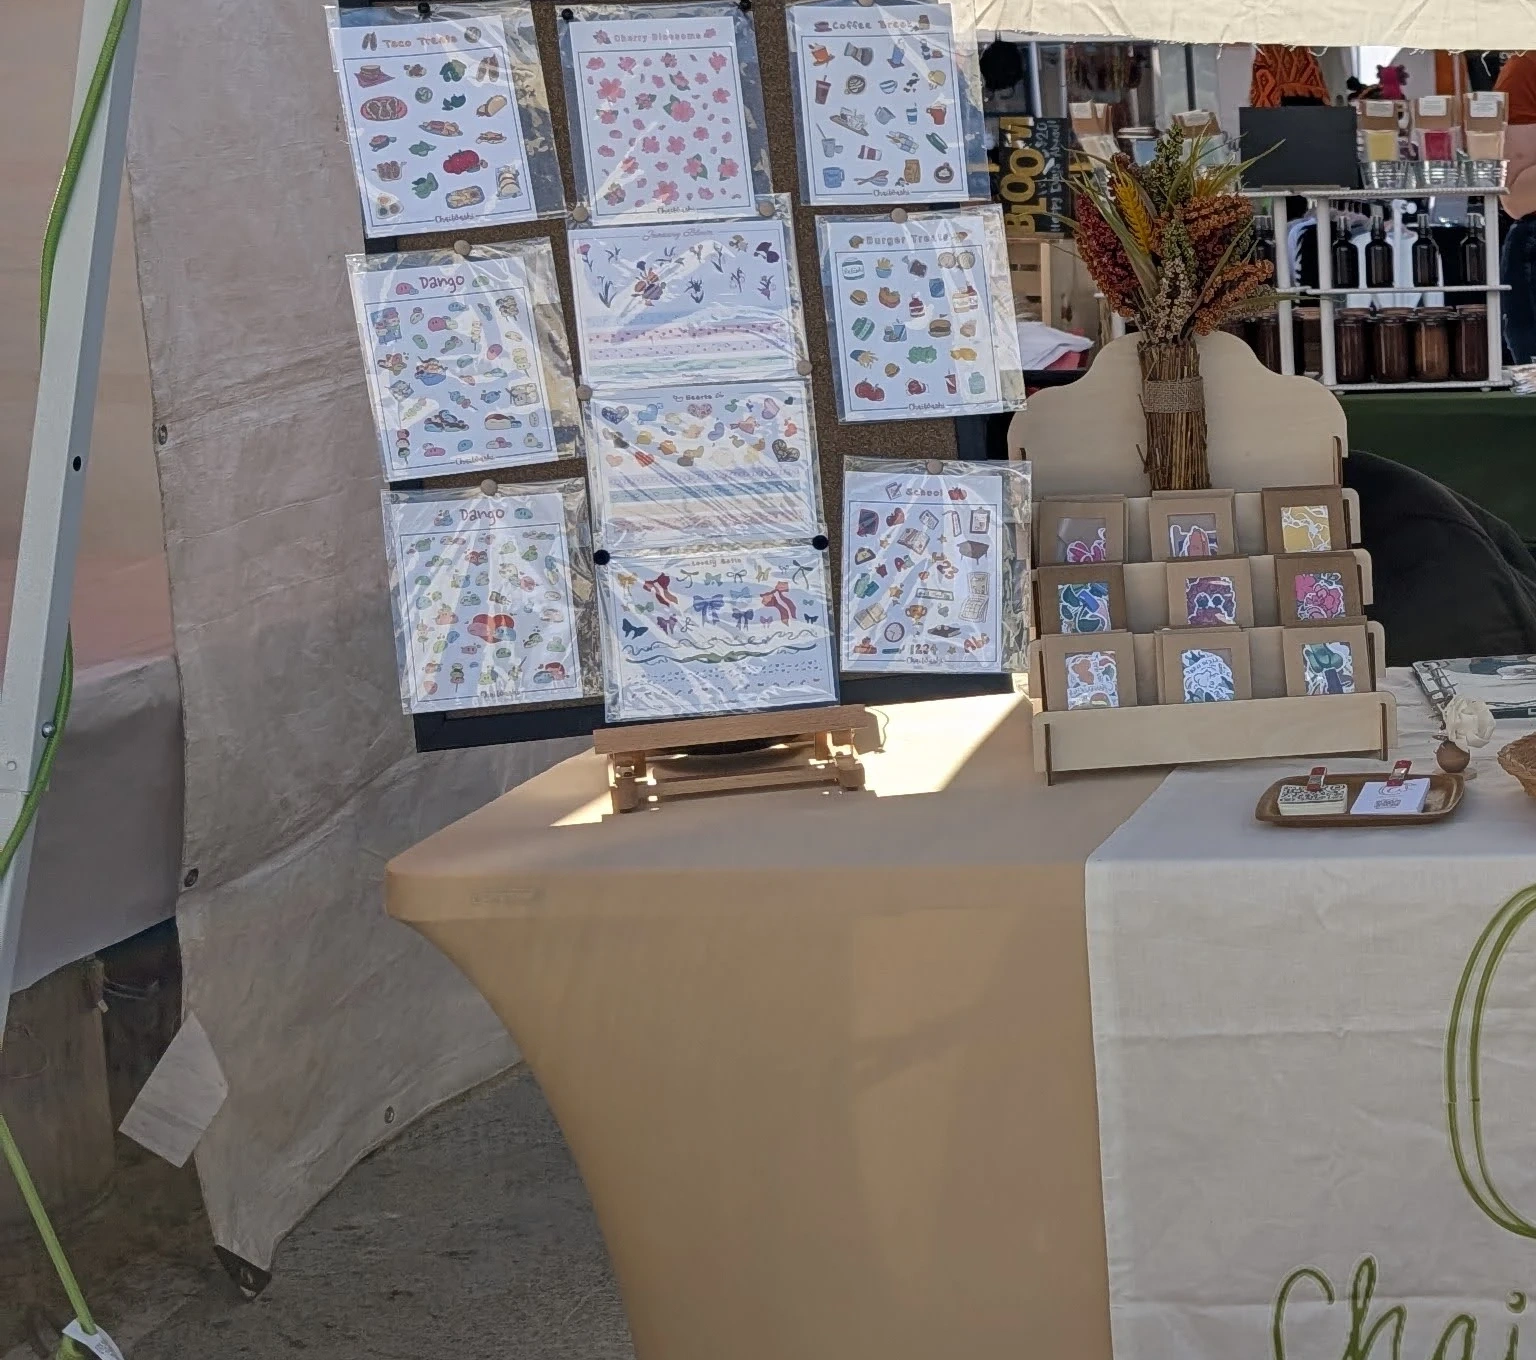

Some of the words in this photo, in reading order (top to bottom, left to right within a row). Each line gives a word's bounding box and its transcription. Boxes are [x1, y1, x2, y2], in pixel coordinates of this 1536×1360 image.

[832, 21, 872, 30] Coffee
[418, 275, 465, 293] Dango
[458, 508, 505, 526] Dango
